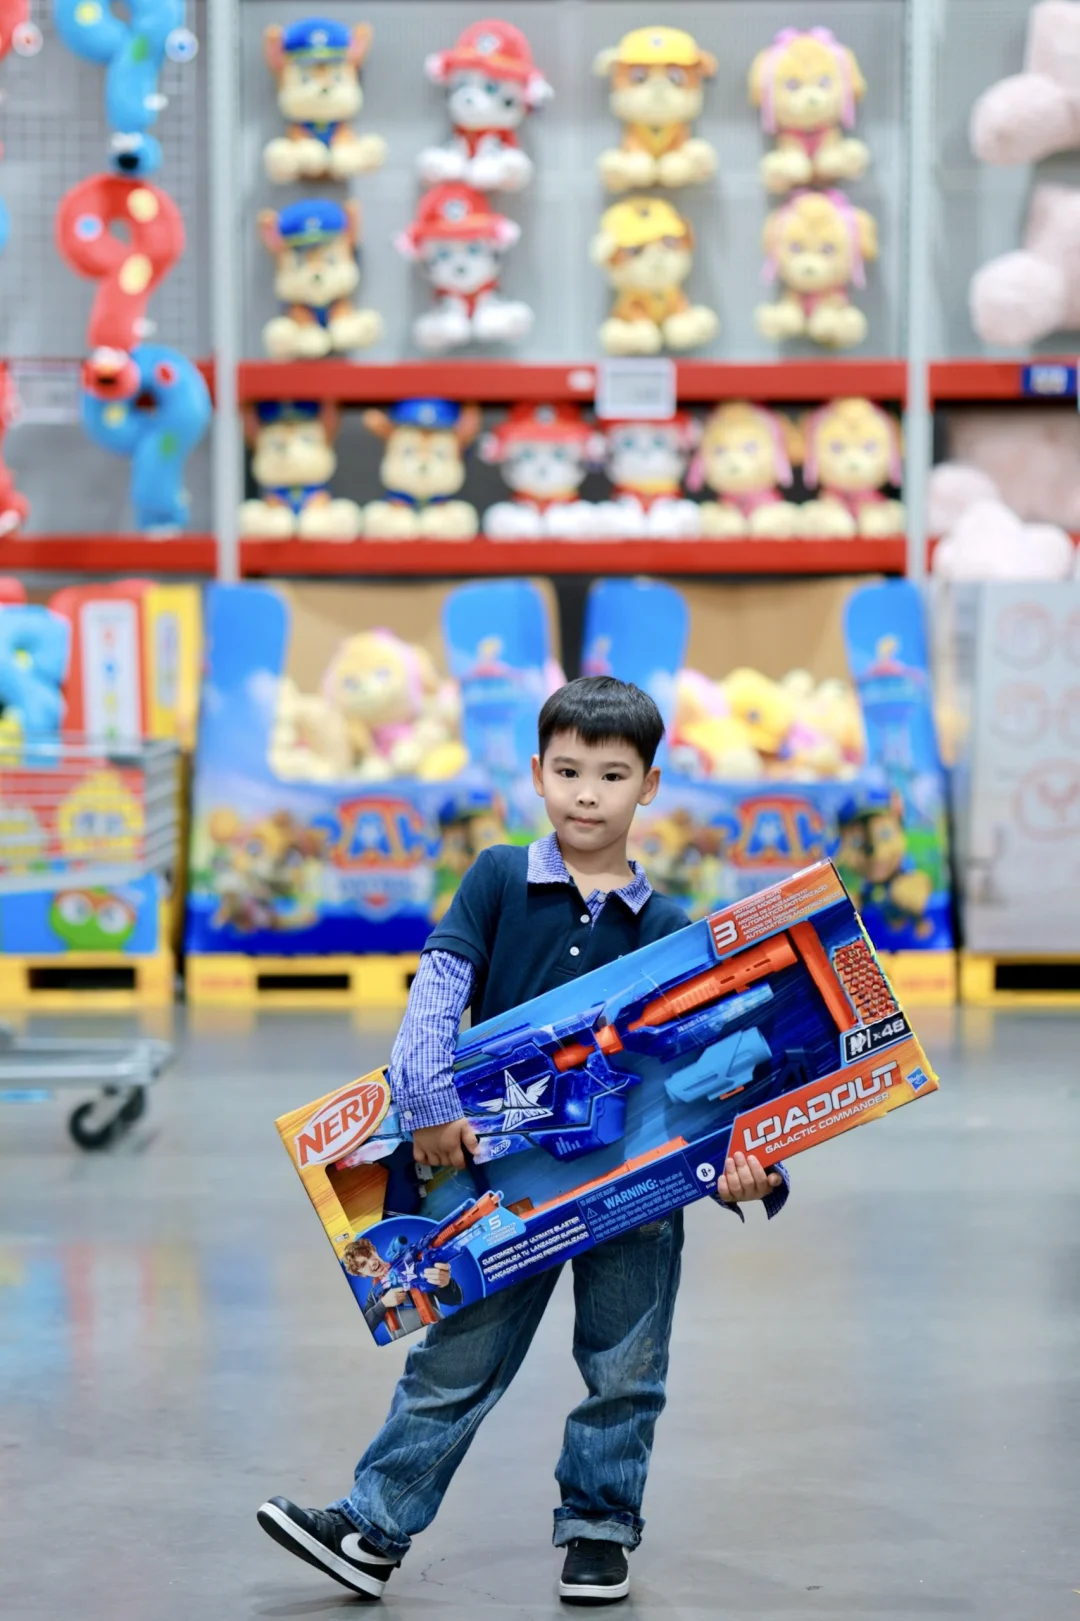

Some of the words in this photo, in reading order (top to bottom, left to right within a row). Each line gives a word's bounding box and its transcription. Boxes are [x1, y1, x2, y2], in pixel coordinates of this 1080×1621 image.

[731, 896, 766, 915] MOTORIZED
[765, 888, 782, 899] AUTO
[737, 913, 759, 926] MODOS
[766, 888, 809, 911] LANZAMIENTO
[756, 894, 782, 909] MODES
[782, 884, 829, 909] MOTORIZADO
[714, 919, 738, 949] 3
[742, 922, 764, 935] MODOS
[742, 1060, 898, 1151] LOADOUT
[297, 1083, 379, 1166] NERF
[765, 1124, 817, 1154] GALACTIC
[819, 1092, 890, 1129] COMMANDER
[700, 1167, 713, 1178] 8+
[602, 1176, 659, 1210] WARNING:
[488, 1214, 502, 1231] 5
[481, 1245, 515, 1266] CUSTOMIZE
[513, 1239, 529, 1251] YOUR
[528, 1228, 554, 1244] ULTIMATE
[552, 1215, 580, 1232] BLASTER
[482, 1252, 522, 1275] PERSONALIZA
[521, 1249, 530, 1257] TU
[529, 1234, 561, 1253] LANZADOR
[560, 1222, 586, 1239] SUPREMO
[517, 1251, 543, 1268] SUPREMO
[542, 1230, 589, 1257] PERSONALIZADO
